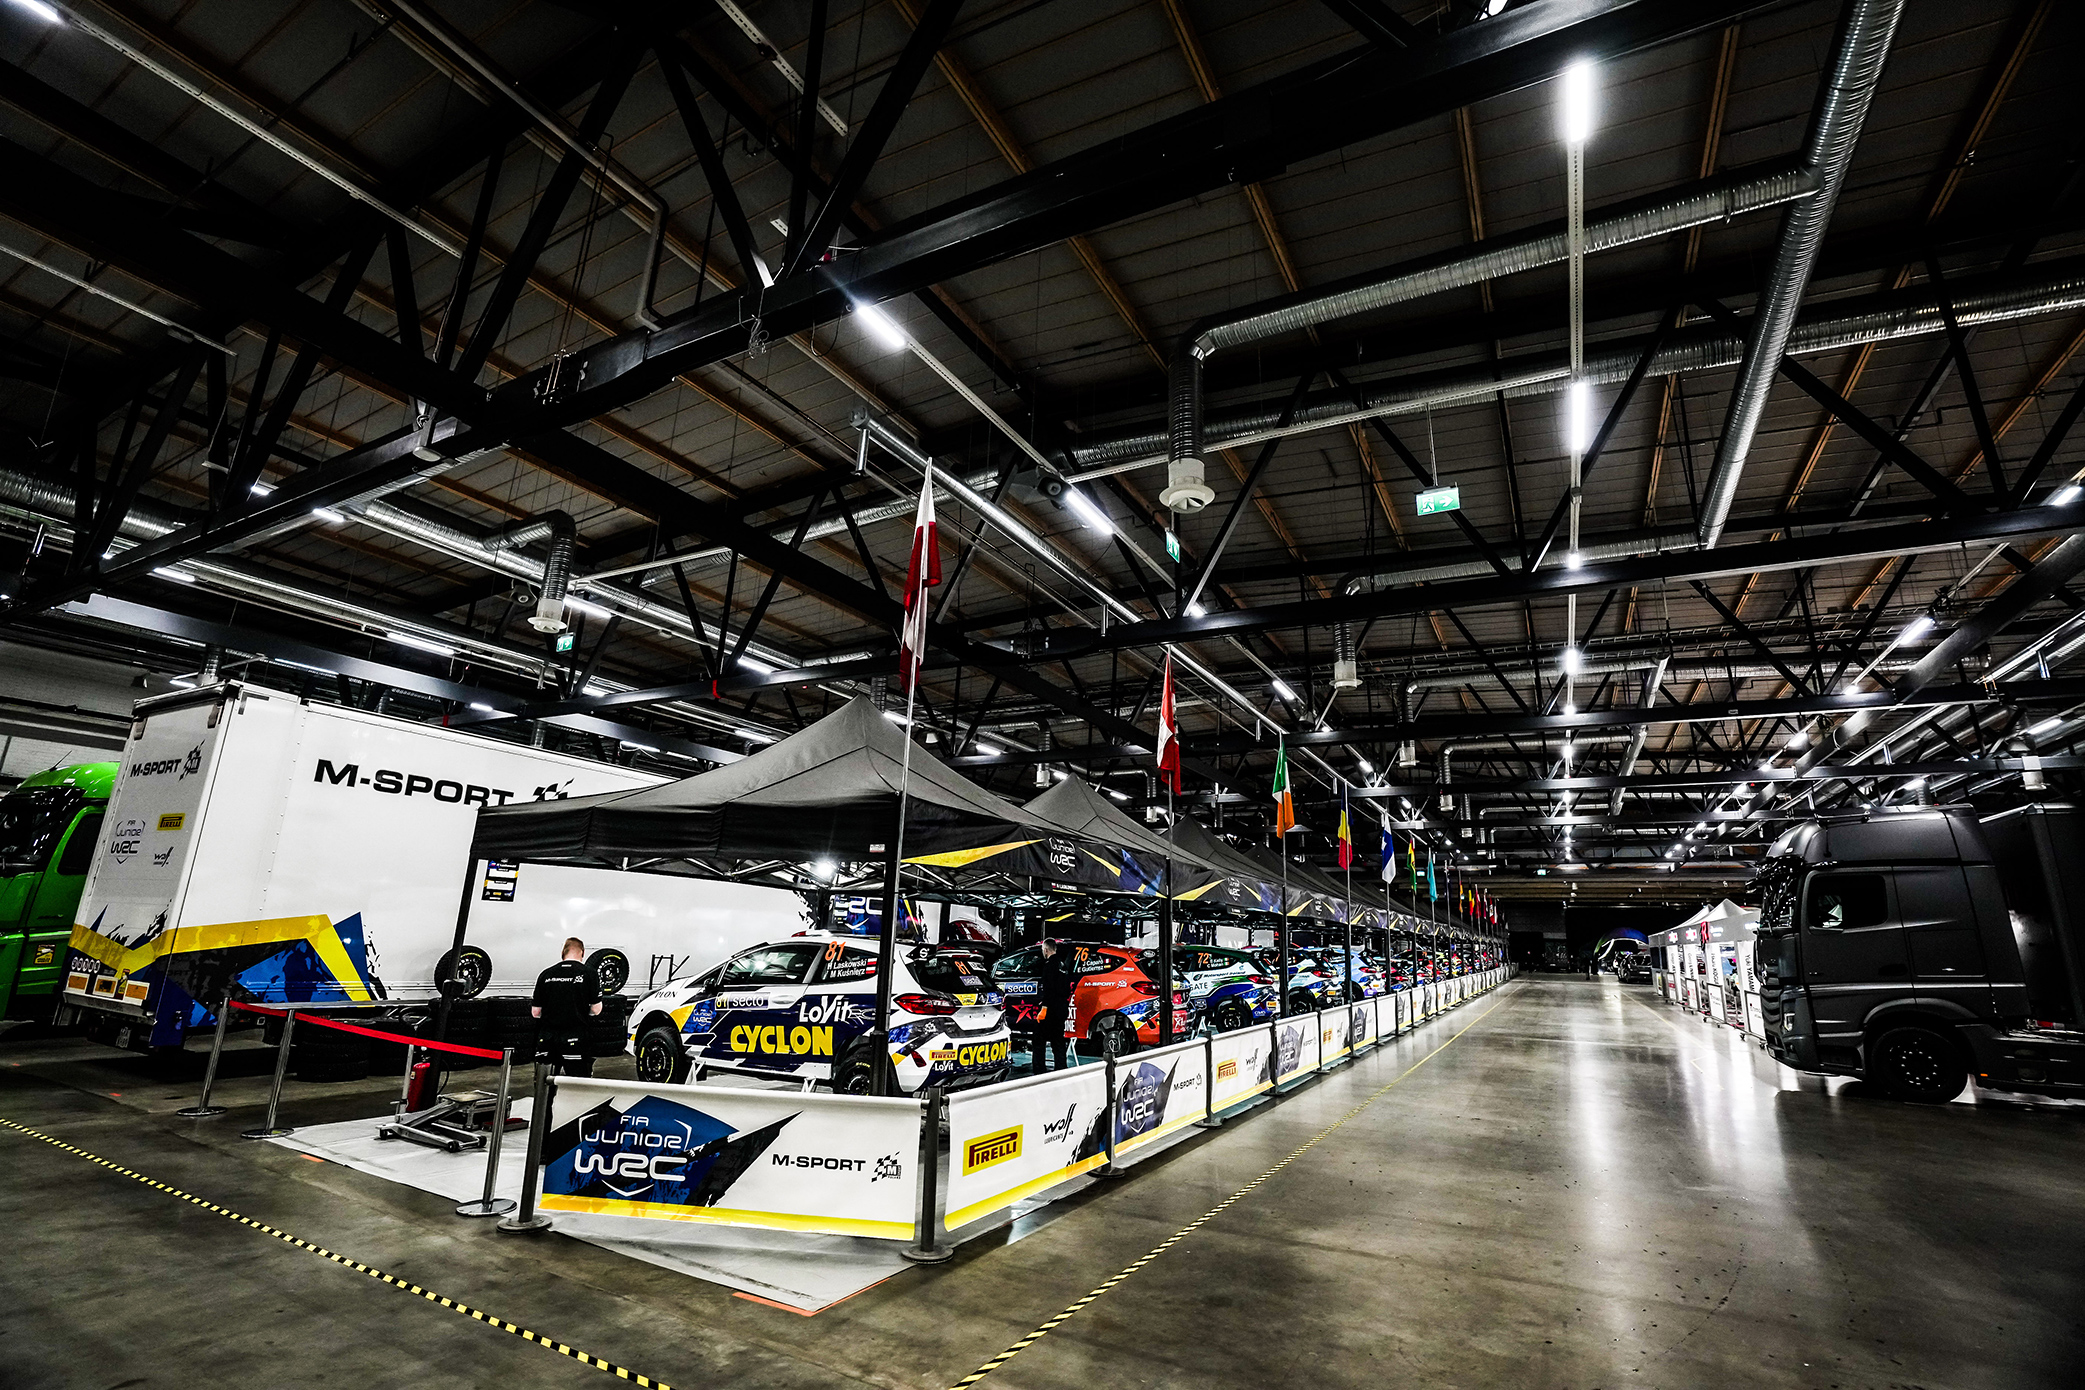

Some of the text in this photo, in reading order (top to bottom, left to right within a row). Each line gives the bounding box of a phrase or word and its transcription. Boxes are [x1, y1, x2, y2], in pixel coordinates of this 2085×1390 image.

[130, 759, 182, 777] M-SPORT
[314, 759, 514, 807] M-SPORT
[160, 816, 182, 828] PIRELLI
[111, 841, 140, 853] WRC
[1050, 852, 1075, 867] WRC
[825, 941, 846, 961] 81
[1074, 947, 1089, 961] 76
[1198, 953, 1209, 964] 72
[833, 959, 867, 969] Laskowski
[1007, 984, 1033, 993] secto
[732, 996, 764, 1007] secto
[730, 1025, 833, 1056] CYCLON
[931, 1051, 956, 1059] PIRELLI
[959, 1041, 1008, 1066] CYCLON
[1218, 1061, 1236, 1080] PIRELLI
[1173, 1078, 1195, 1091] M-SPORT
[1121, 1098, 1154, 1126] WRC
[620, 1115, 649, 1127] FIA
[584, 1129, 682, 1149] JUNIOR
[968, 1131, 1018, 1168] PIRELLI
[574, 1149, 688, 1182] WRC
[772, 1155, 866, 1172] M-SPORT
